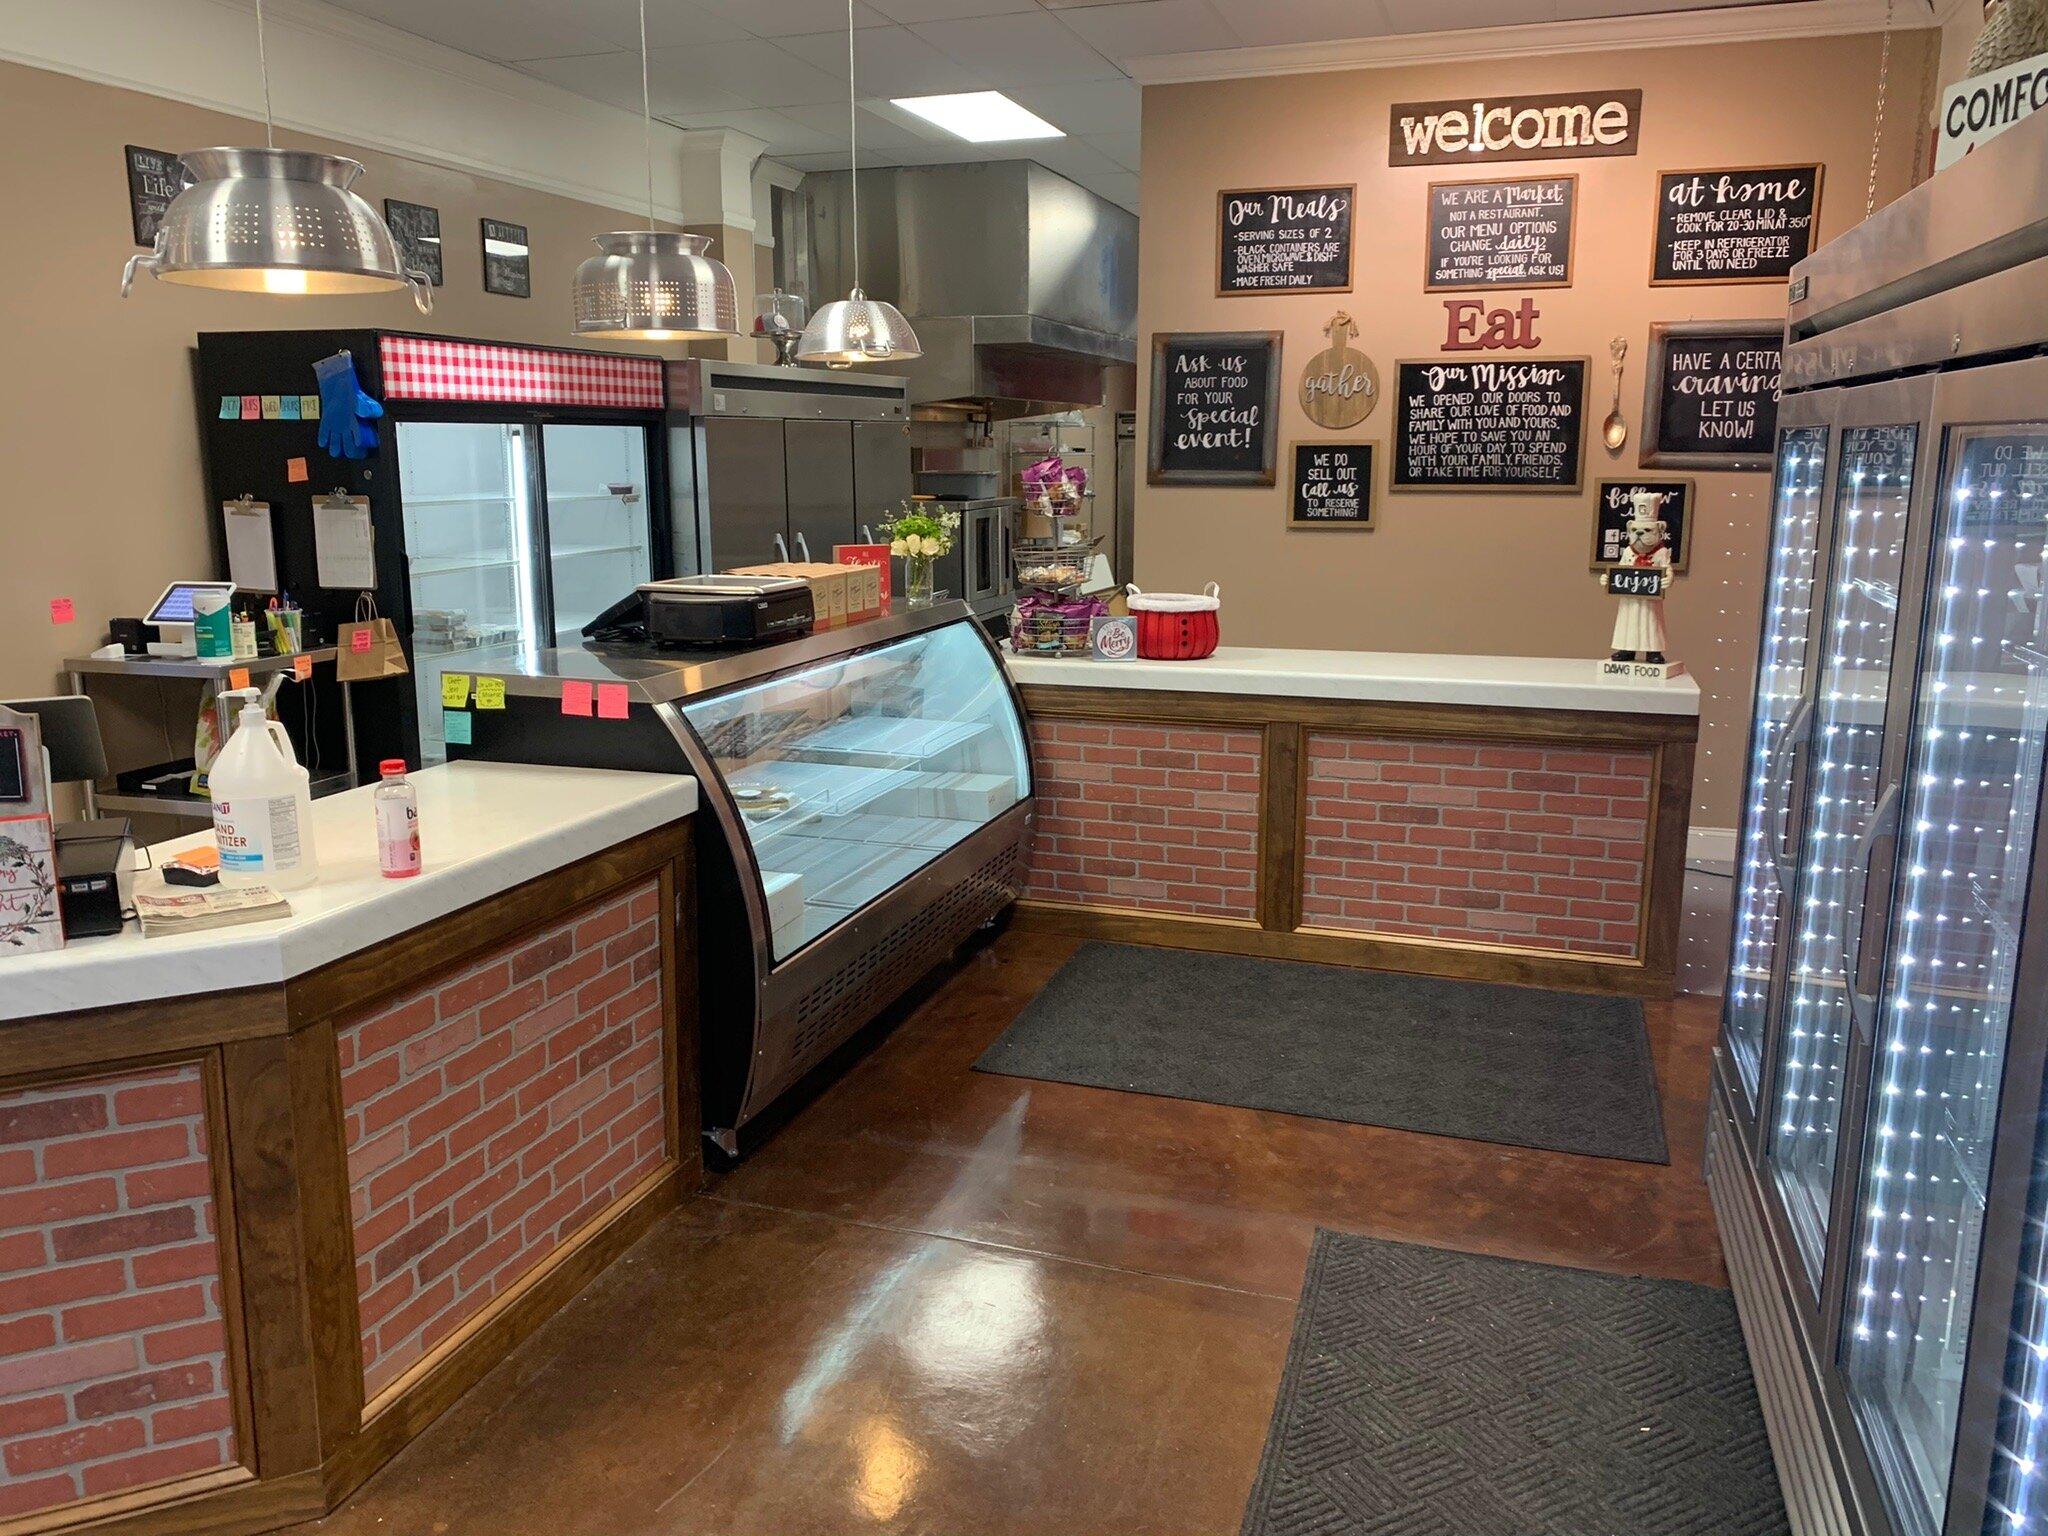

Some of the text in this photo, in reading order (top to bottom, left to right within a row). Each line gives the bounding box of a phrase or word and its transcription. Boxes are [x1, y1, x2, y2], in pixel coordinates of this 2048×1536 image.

[1400, 101, 1629, 156] welcome
[1442, 192, 1458, 205] WE
[1464, 190, 1488, 204] ARE
[1493, 190, 1502, 203] A
[1669, 175, 1806, 206] at home
[1230, 195, 1347, 225] Our Meals
[1450, 208, 1543, 221] NOT A RESTAURANT.
[1720, 209, 1751, 220] CLEAR
[1757, 209, 1774, 219] LID
[1779, 208, 1787, 220] &
[1279, 229, 1304, 239] SIZES
[1310, 229, 1320, 238] OF
[1325, 227, 1332, 238] 2
[1442, 221, 1556, 239] OUR MENU OPTIONS
[1676, 223, 1701, 233] COOK
[1706, 221, 1724, 231] FOR
[1727, 220, 1755, 231] 20-30
[1270, 243, 1320, 253] CONTAINERS
[1323, 243, 1340, 252] ARE
[1450, 239, 1492, 252] CHANGE
[1705, 239, 1714, 249] IN
[1717, 236, 1789, 248] REFRIGERATOR
[1307, 252, 1313, 262] &
[1441, 258, 1450, 267] IF
[1489, 254, 1528, 264] LOOKING
[1532, 253, 1552, 264] FOR
[1674, 246, 1789, 260] FOR 3 DAYS OR FREEZE
[1237, 262, 1294, 273] WASHER SAFE
[1673, 258, 1757, 270] UNTIL YOU NEED
[1436, 268, 1482, 279] SOMETHING
[1528, 266, 1545, 275] ASK
[1549, 265, 1564, 275] US!
[1260, 276, 1287, 286] FRESH
[1289, 275, 1313, 285] DAILY
[1441, 298, 1541, 351] Eat
[1175, 355, 1247, 373] Ask us
[1673, 353, 1712, 371] HAVE
[1720, 353, 1730, 370] A
[1185, 377, 1248, 388] ABOUT FOOD
[1305, 364, 1375, 402] gather
[1421, 364, 1565, 391] Our Mission
[1673, 372, 1782, 402] craving
[1178, 392, 1232, 404] FOR YOUR
[1409, 392, 1561, 407] WE OPENED OUR DOORS TO
[1410, 404, 1571, 420] SHARE OUR LOVE OF FOOD AND
[1701, 401, 1755, 416] LET US
[1180, 406, 1259, 431] special
[1409, 417, 1560, 432] FAMILY WITH YOU AND YOURS.
[1699, 420, 1753, 438] KNOW!
[1174, 428, 1251, 449] event!
[1409, 431, 1550, 444] WE HOPE TO SAVE YOU AN
[1409, 442, 1567, 456] HOUR OF YOUR DAY TO SPEND
[1314, 454, 1347, 466] WE DO
[1408, 456, 1436, 466] WITH
[1441, 455, 1468, 466] YOUR
[1308, 468, 1333, 480] SELL
[1409, 466, 1561, 479] OR TAKE TIME FOR YOURSELF.
[1333, 483, 1358, 497] us
[1307, 499, 1359, 508] TO RESERVE
[1307, 508, 1357, 517] SOMETHING!
[1611, 571, 1660, 593] enjoy
[1112, 628, 1125, 638] Be
[1101, 635, 1130, 652] Merry
[1604, 664, 1660, 677] DAWG FOOD
